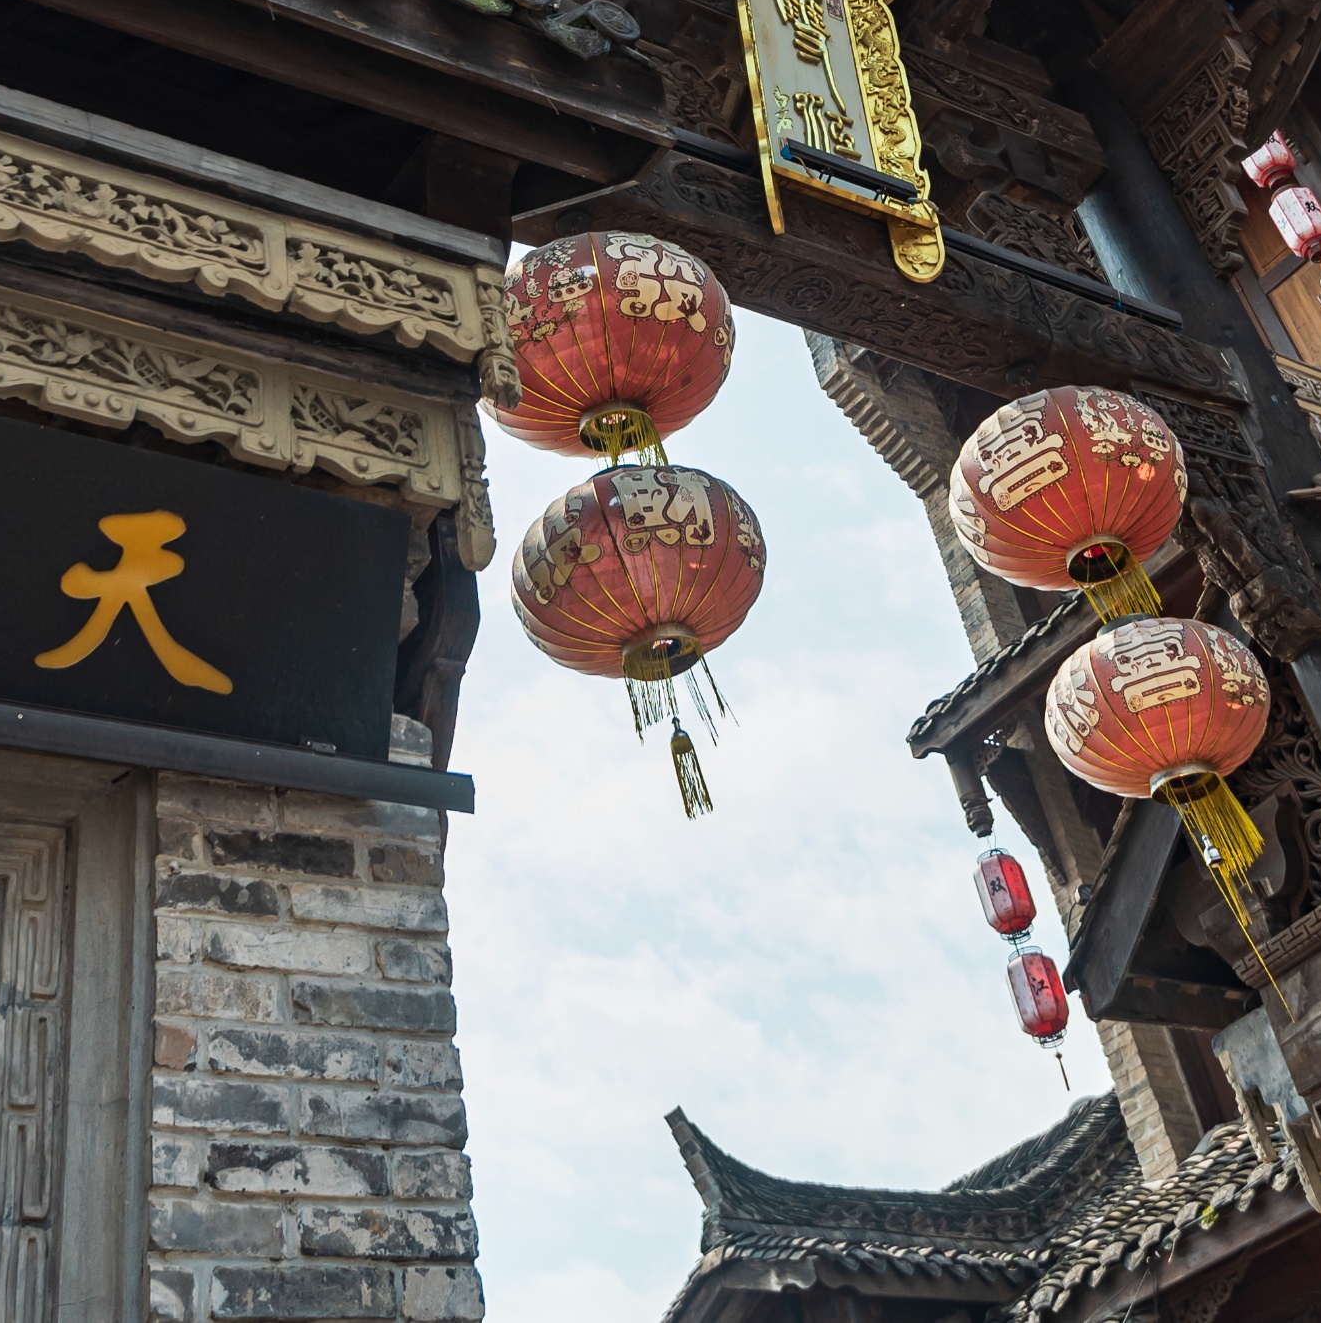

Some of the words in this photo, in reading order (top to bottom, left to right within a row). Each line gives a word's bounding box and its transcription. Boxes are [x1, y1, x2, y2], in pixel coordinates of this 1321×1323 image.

[1304, 200, 1321, 213] 双
[988, 875, 1008, 897] 双
[1030, 976, 1049, 996] 江
